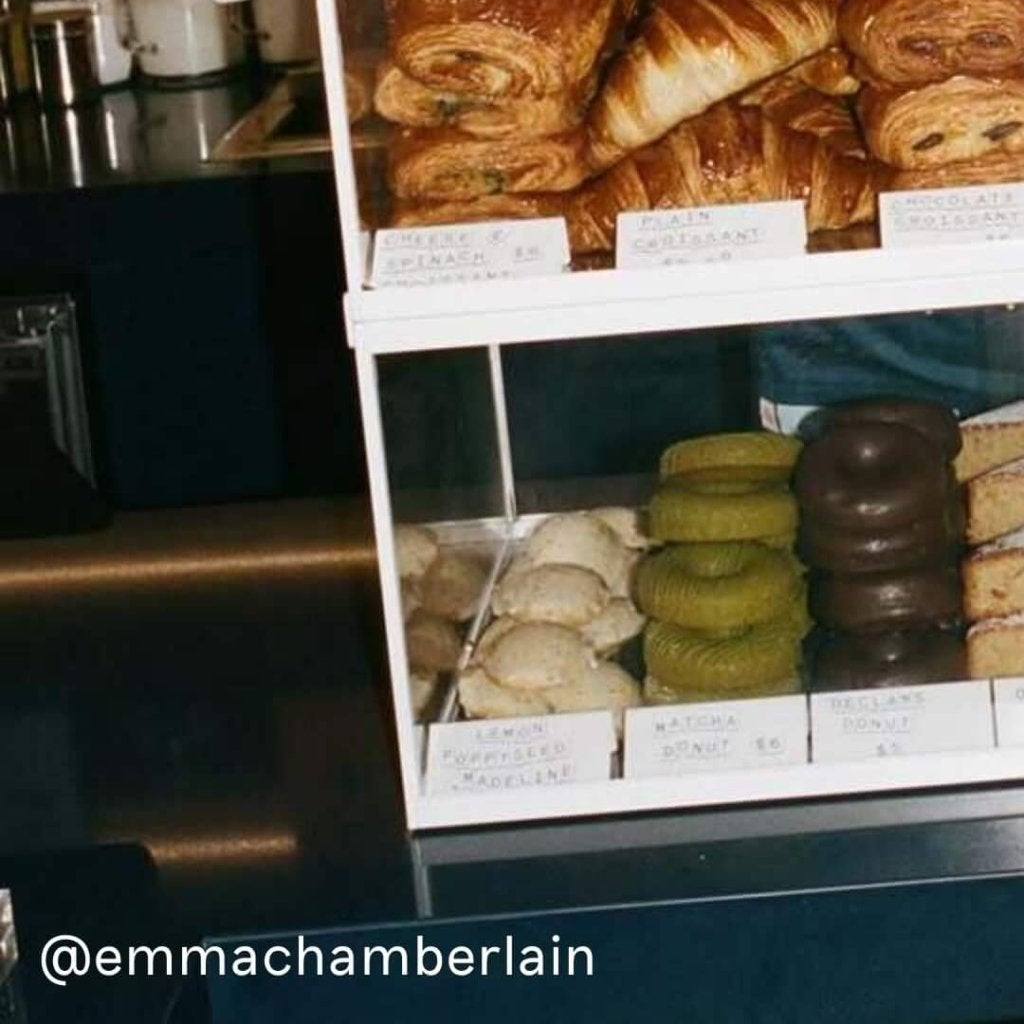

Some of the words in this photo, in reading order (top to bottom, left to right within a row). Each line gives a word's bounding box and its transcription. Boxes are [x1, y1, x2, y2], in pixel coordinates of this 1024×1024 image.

[640, 210, 711, 227] PLAIN
[383, 230, 470, 248] CHEESE
[386, 250, 486, 270] SPINACH
[655, 714, 739, 734] MATCHA
[842, 715, 911, 731] DONUT
[662, 737, 730, 758] DONUT
